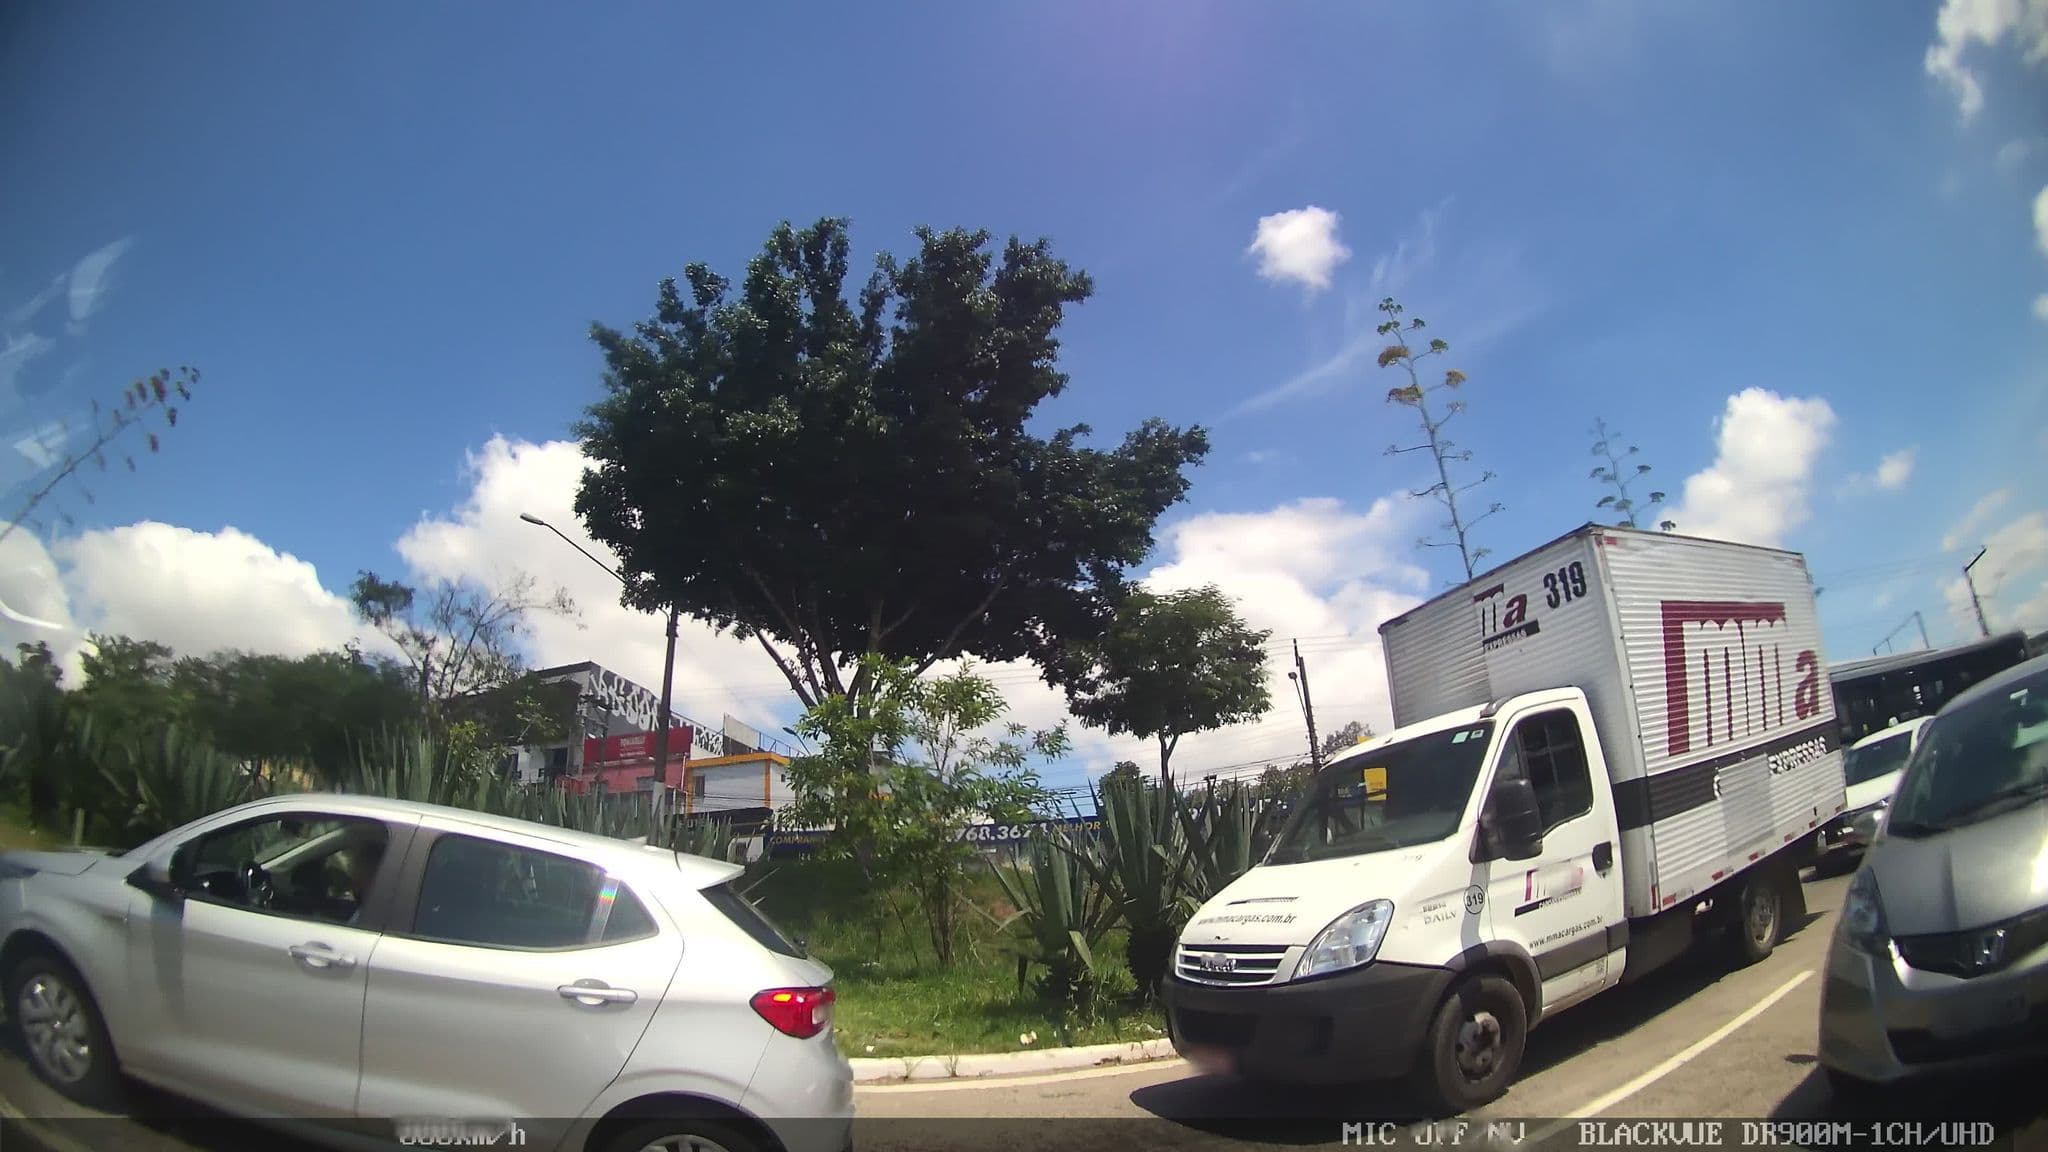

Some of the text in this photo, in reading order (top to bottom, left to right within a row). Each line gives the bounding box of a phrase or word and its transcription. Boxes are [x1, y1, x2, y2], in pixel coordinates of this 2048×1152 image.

[1543, 561, 1587, 609] 319
[1466, 892, 1484, 907] 319
[1424, 911, 1457, 925] DAILY
